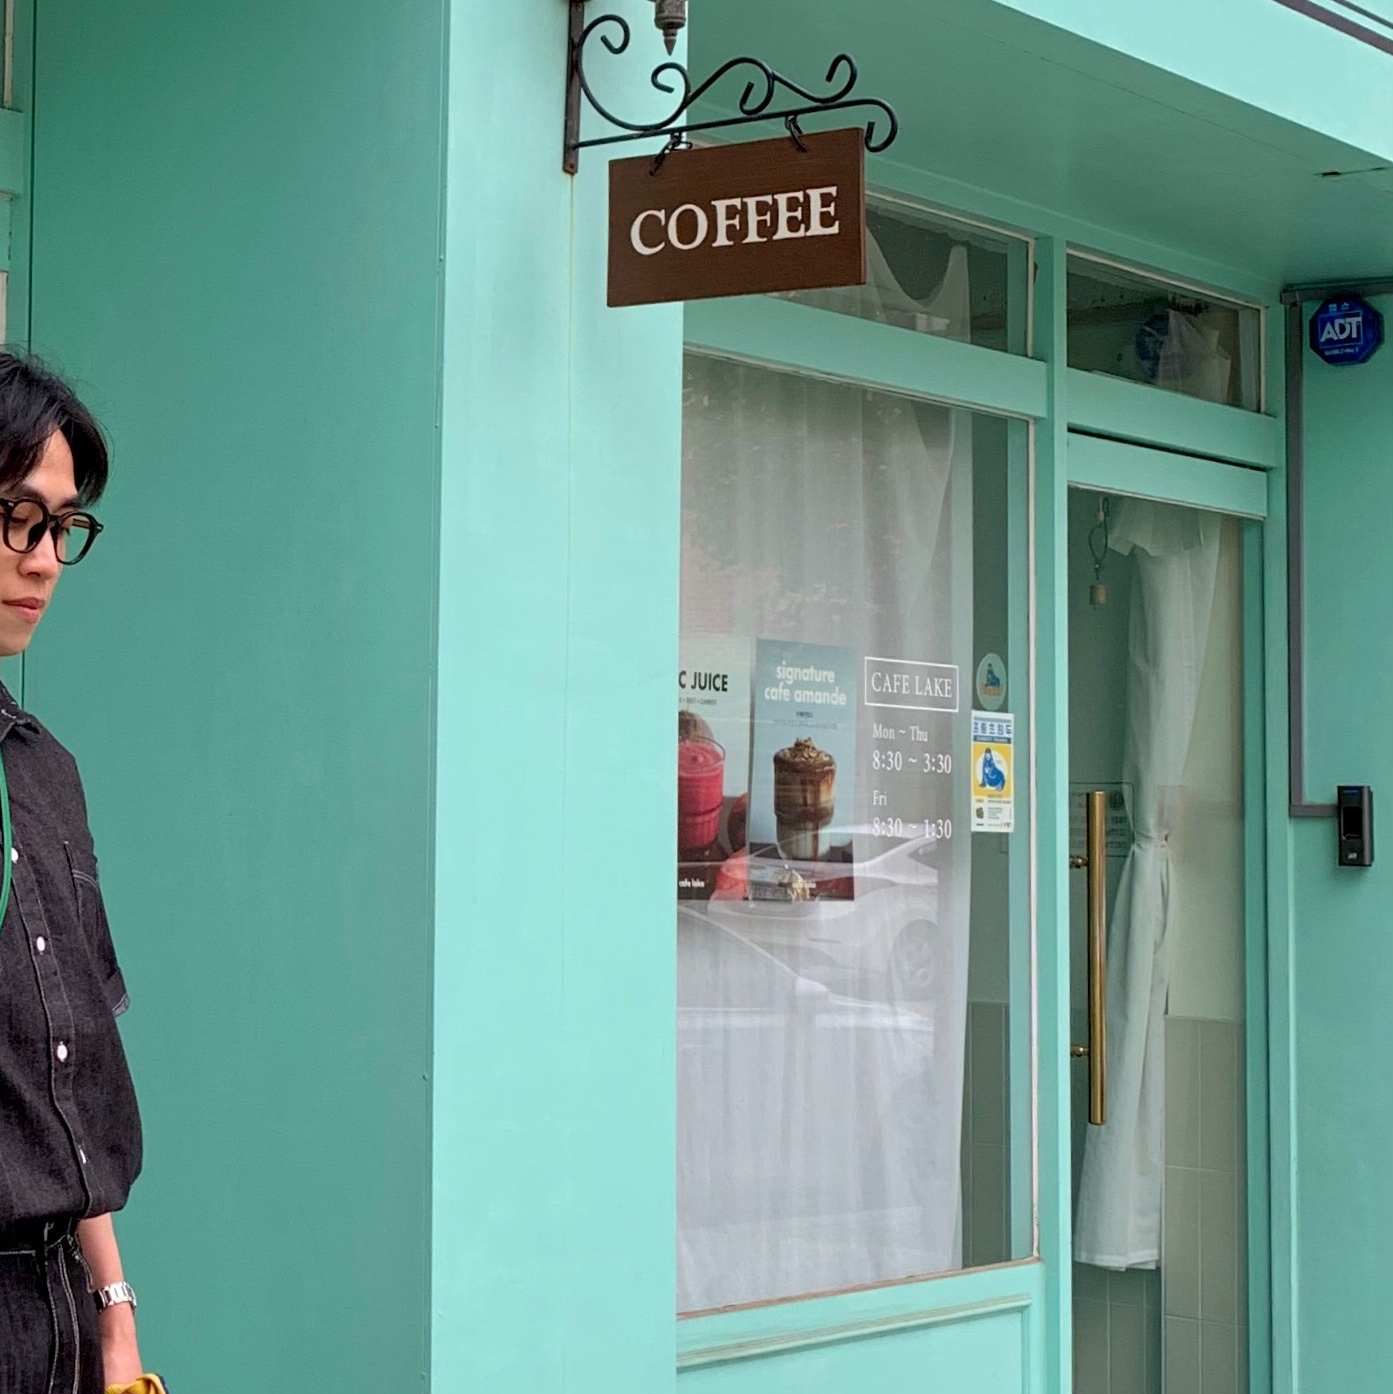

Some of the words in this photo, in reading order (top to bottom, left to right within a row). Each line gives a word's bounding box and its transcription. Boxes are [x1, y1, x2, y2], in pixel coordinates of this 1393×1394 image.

[630, 186, 840, 255] COFFEE
[1320, 316, 1362, 342] ADT
[691, 672, 728, 692] JUICE
[776, 660, 835, 685] signature
[871, 671, 910, 694] CAFE
[915, 675, 953, 698] LAKE
[764, 681, 791, 702] cafe
[794, 686, 847, 706] amande
[872, 723, 895, 740] Mon
[909, 725, 928, 742] Thu
[872, 750, 903, 771] 8:30
[923, 753, 952, 774] 3:30
[873, 790, 887, 806] Fri
[872, 817, 903, 838] 8:30
[924, 819, 952, 840] 1:30
